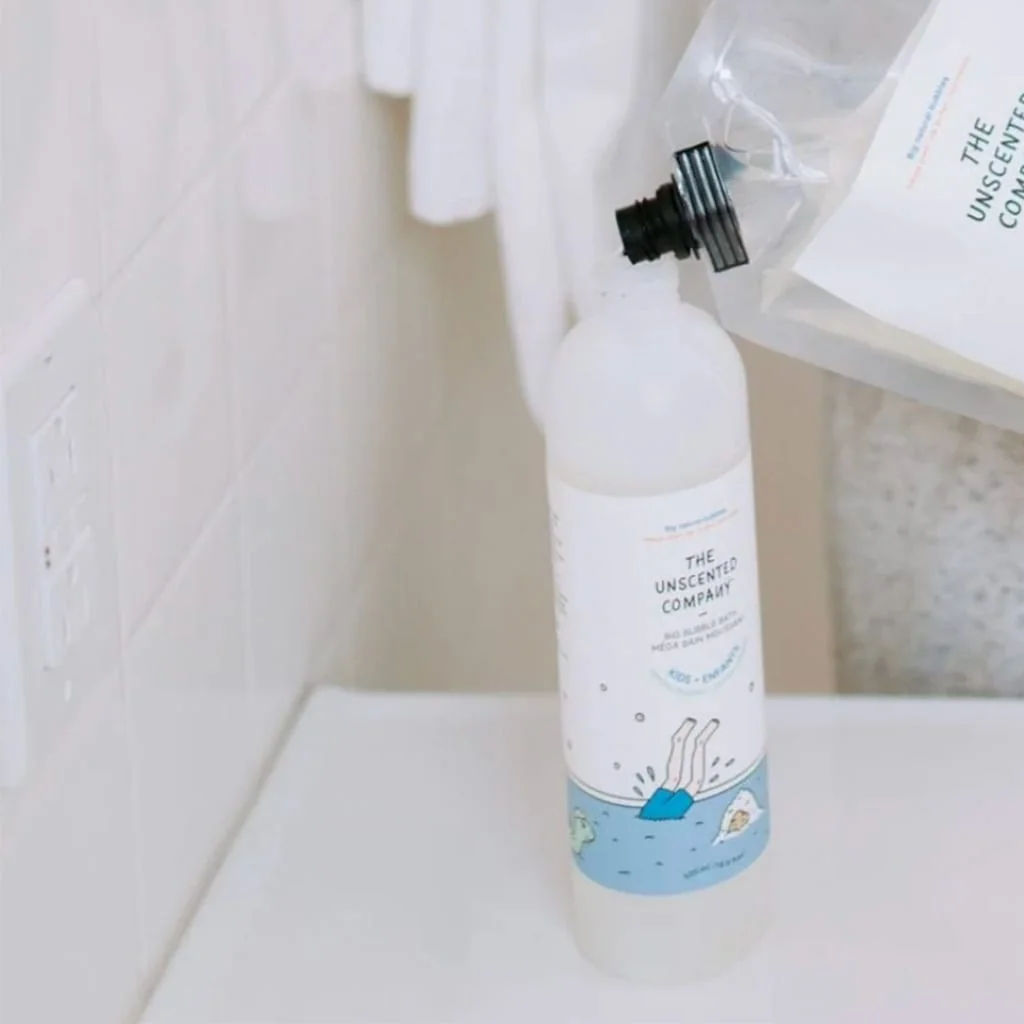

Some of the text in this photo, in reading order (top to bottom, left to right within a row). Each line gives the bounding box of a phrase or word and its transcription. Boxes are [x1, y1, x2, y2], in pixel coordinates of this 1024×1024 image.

[960, 117, 995, 165] THE
[654, 556, 739, 594] UNSCENTED
[685, 548, 716, 570] THE
[661, 580, 732, 614] COMPANY
[667, 666, 692, 685] KIDS
